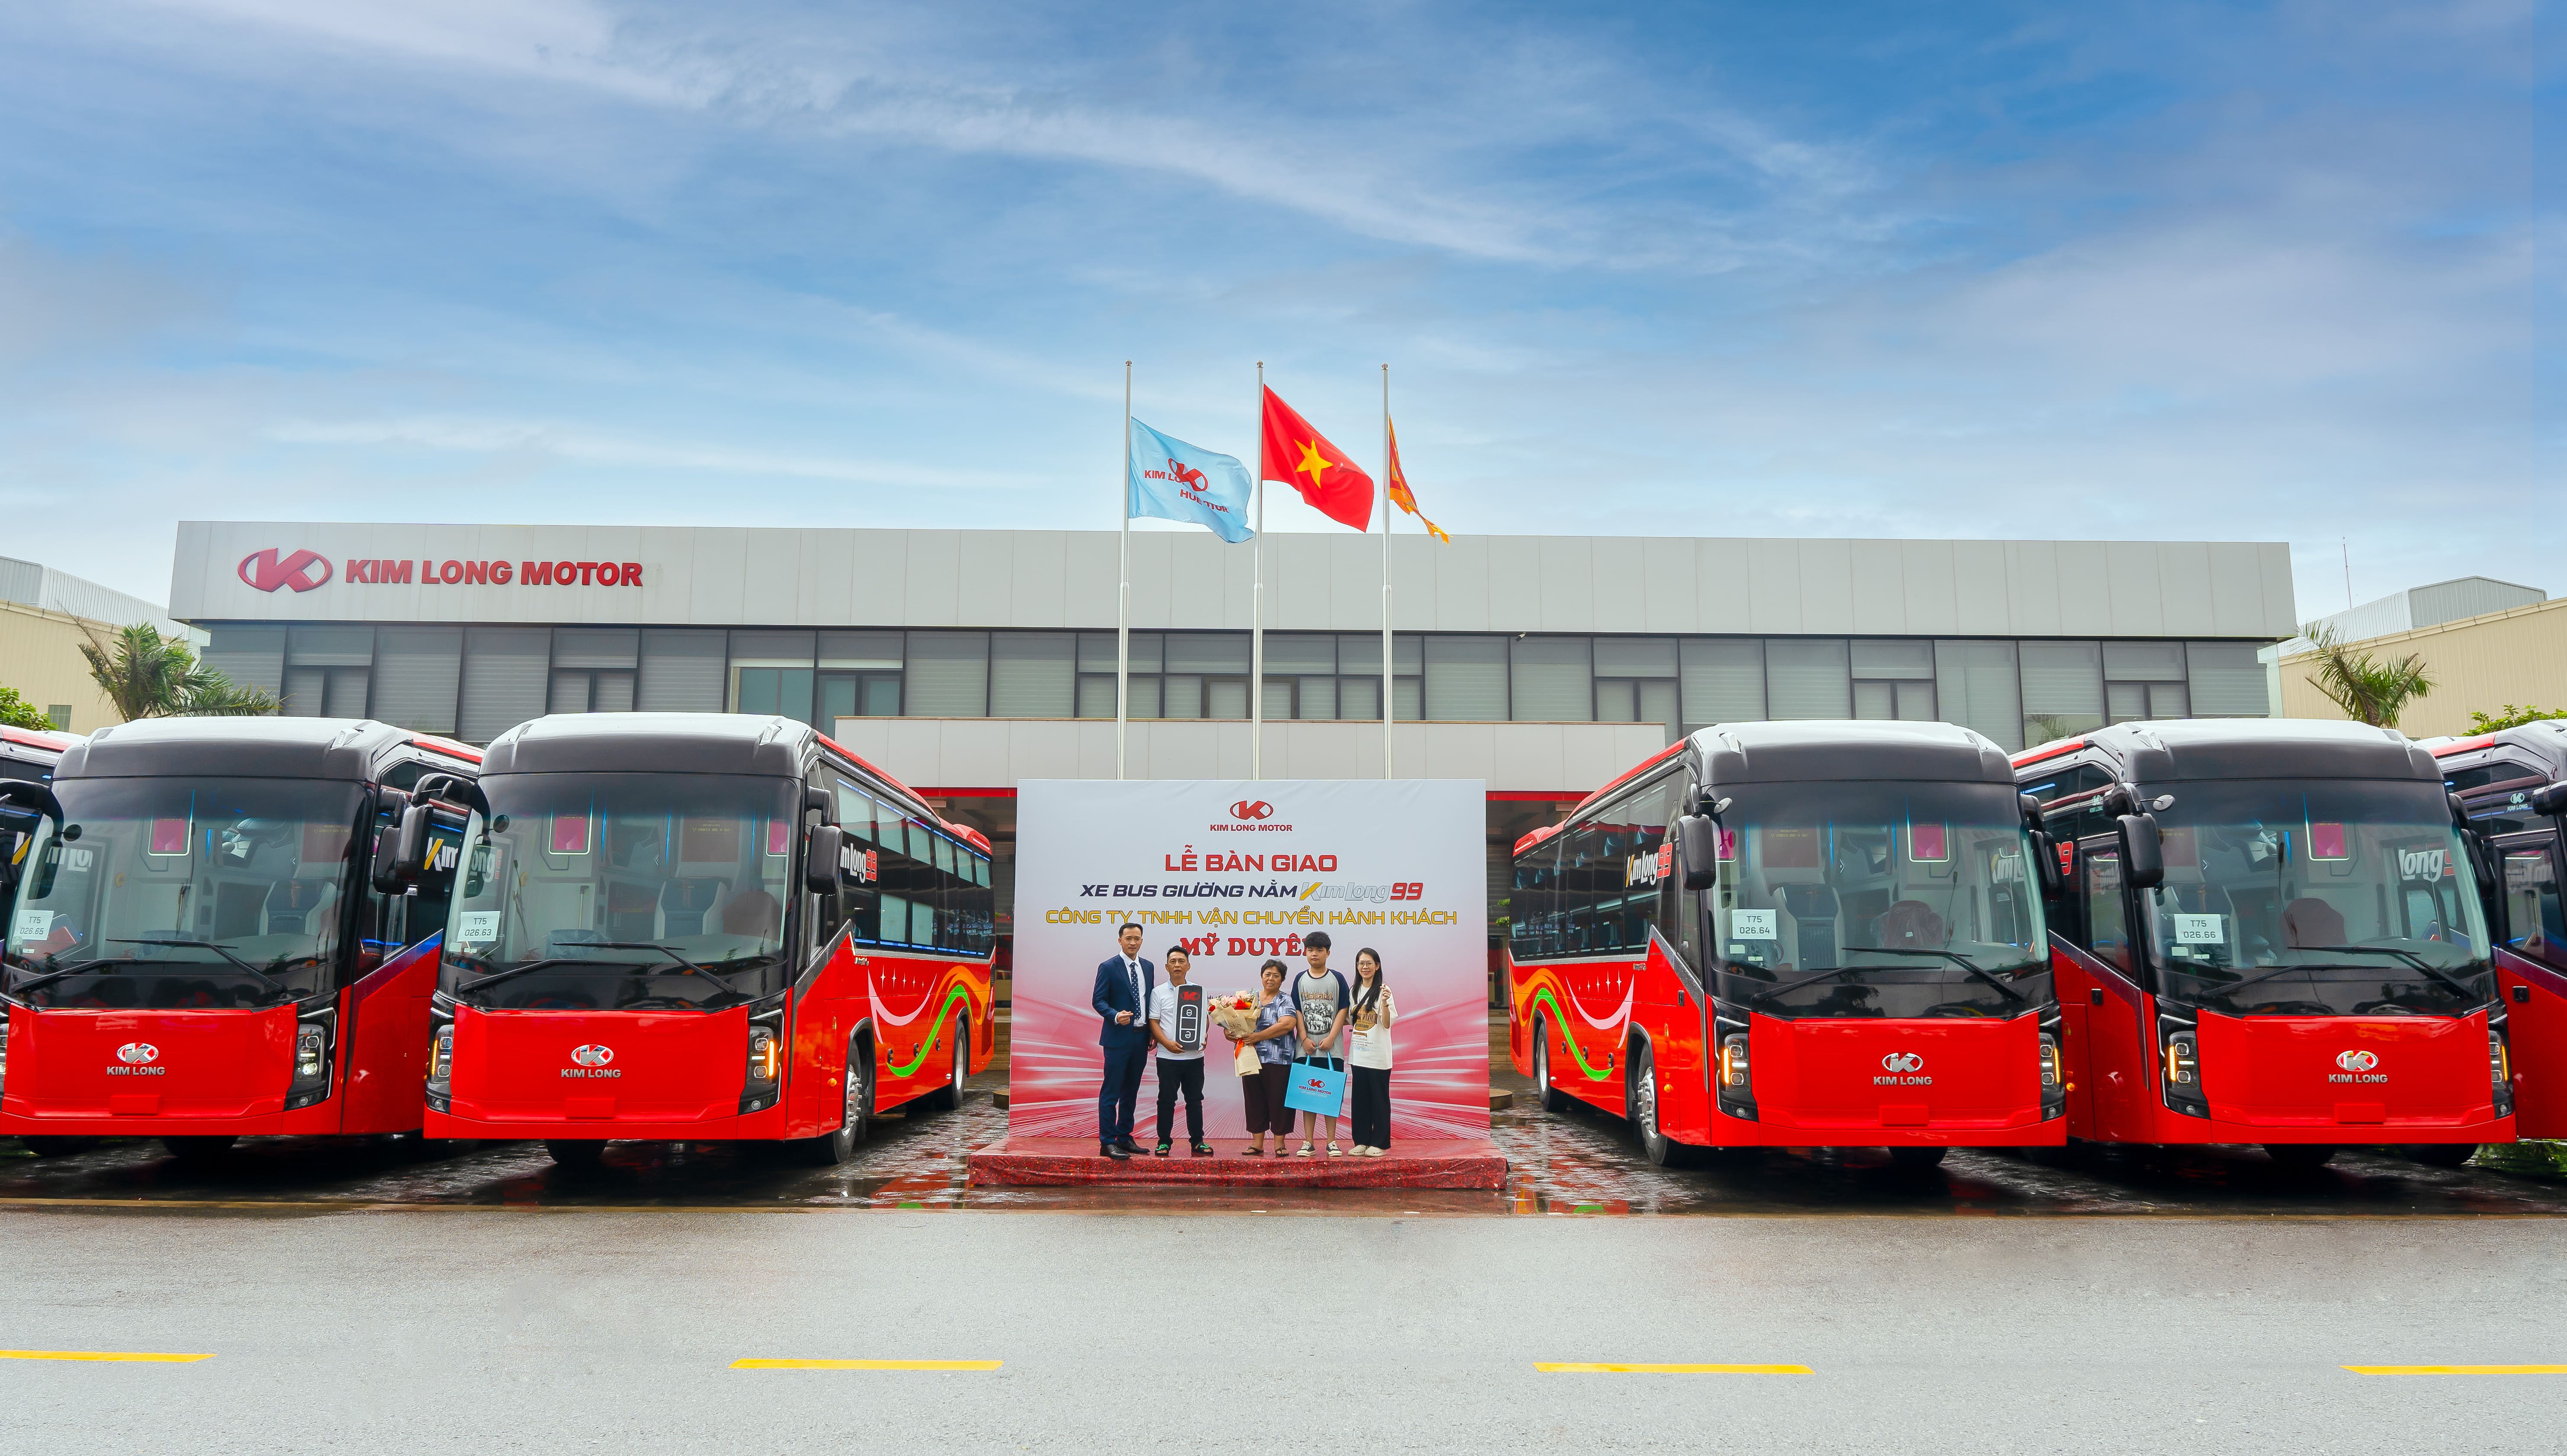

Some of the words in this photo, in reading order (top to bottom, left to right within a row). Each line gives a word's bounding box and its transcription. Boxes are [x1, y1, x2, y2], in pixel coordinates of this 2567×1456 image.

[1144, 470, 1166, 479] KIM
[1180, 489, 1202, 505] HUE
[346, 559, 413, 584] KIM
[421, 560, 512, 585] LONG
[520, 561, 643, 587] MOTOR
[1165, 844, 1198, 872] LỄ
[1205, 850, 1263, 872] BÀN
[1271, 854, 1337, 872] GIAO
[1079, 885, 1109, 897] XE
[1112, 885, 1157, 897] BUS
[1162, 882, 1244, 898] GIƯỜNG
[1248, 879, 1298, 898] NẰM
[1046, 907, 1101, 924] CÔNG
[1106, 911, 1133, 924] TY
[1137, 911, 1192, 924] TNHH
[1197, 908, 1237, 927] VẬN
[1243, 905, 1324, 925] CHUYỂN
[1329, 908, 1385, 925] HÀNH
[1391, 908, 1457, 925] KHÁCH
[1746, 915, 1763, 924] T75
[472, 917, 487, 925] T75
[464, 928, 492, 937] 026.63
[1739, 927, 1770, 935] 026.64
[2183, 930, 2216, 939] 026.66
[1180, 932, 1220, 956] MỸ
[1227, 933, 1307, 956] DUYÊ
[106, 1066, 130, 1075] KIM
[132, 1066, 165, 1075] LONG
[561, 1069, 585, 1078] KIM
[588, 1069, 621, 1078] LONG
[1873, 1076, 1897, 1086] KIM
[1900, 1076, 1933, 1086] LONG
[2329, 1074, 2353, 1083] KIM
[2355, 1074, 2388, 1083] LONG
